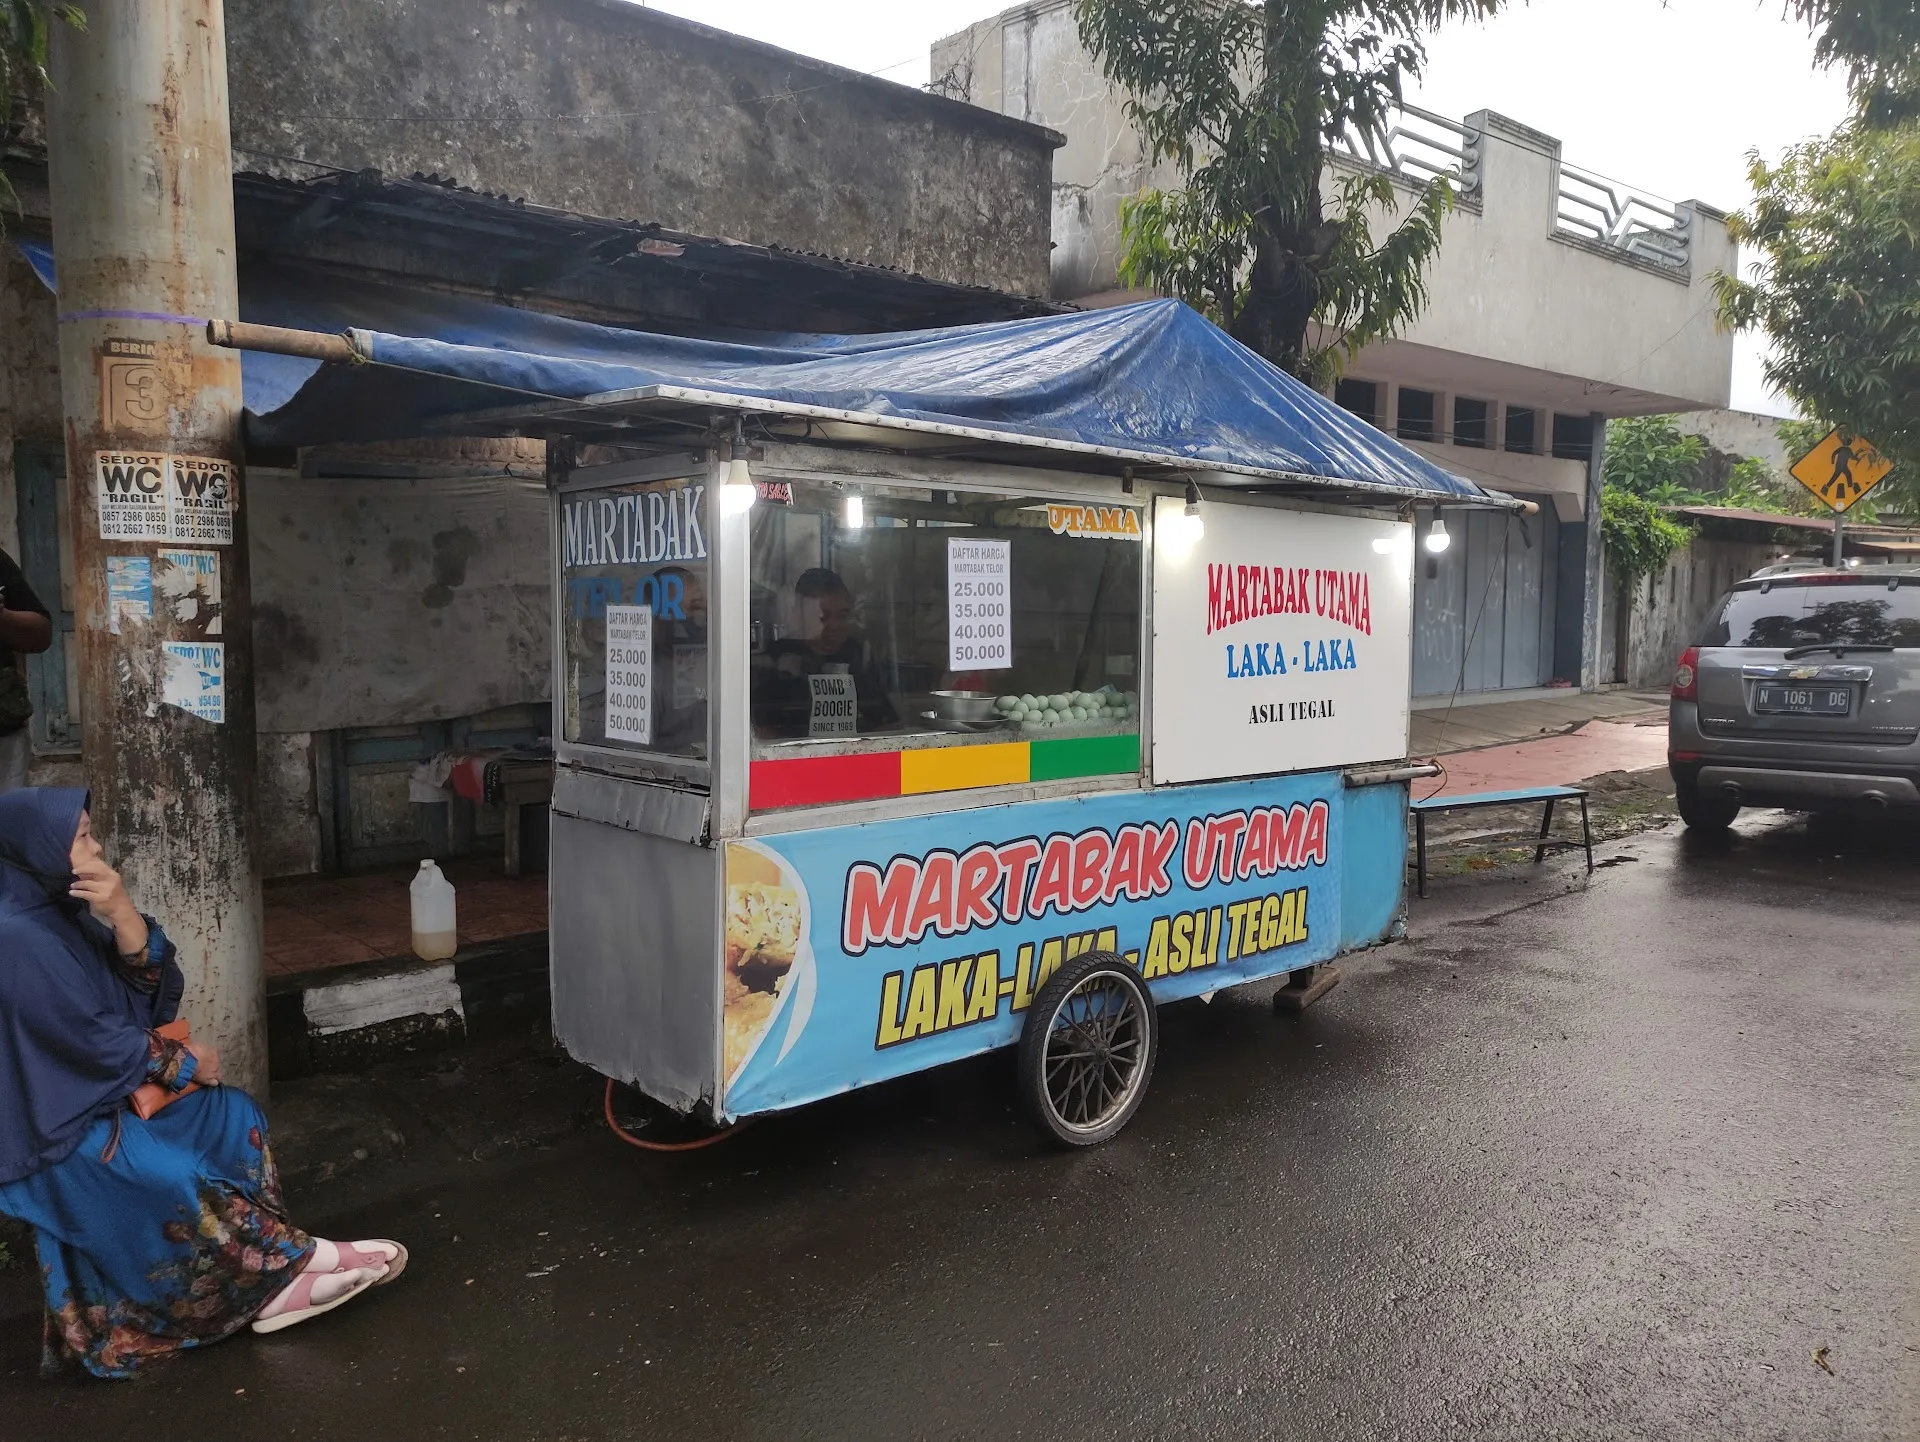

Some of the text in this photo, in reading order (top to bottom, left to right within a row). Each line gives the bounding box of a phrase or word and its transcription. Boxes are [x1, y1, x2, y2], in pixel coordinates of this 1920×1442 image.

[100, 455, 163, 466] SEDOT
[173, 460, 228, 472] SEDOT
[102, 465, 162, 494] WC
[175, 469, 228, 499] WC
[102, 512, 166, 522] 0857 2986 0850
[174, 514, 194, 525] 0857
[197, 515, 214, 526] 2986
[564, 485, 707, 567] MARTABAK
[1048, 504, 1140, 538] UTAMA
[102, 524, 167, 535] 0812 2662 7159
[175, 526, 195, 537] 0812
[198, 528, 215, 538] 2662
[952, 547, 1005, 560] DAFTAR HARGA
[196, 555, 215, 574] WC
[954, 563, 1004, 573] MARTABAK TELOR
[954, 582, 1004, 597] 25.000
[1207, 563, 1310, 635] MARTABAK
[1315, 569, 1371, 636] UTAMA
[609, 612, 647, 626] DAFTAR HARGA
[954, 603, 1004, 618] 35.000
[954, 623, 1005, 639] 40.000
[202, 647, 220, 668] WC
[610, 648, 646, 666] 25.000
[955, 644, 1005, 660] 50.000
[1227, 642, 1287, 678] LAKA
[1304, 638, 1357, 673] LAKA
[610, 670, 646, 688] 35.000
[813, 678, 845, 696] BOMB
[610, 692, 646, 711] 40.000
[1760, 689, 1847, 706] N 1061 DG
[814, 699, 853, 717] BOOGIE
[1248, 699, 1336, 724] ASLI TEGAL
[610, 714, 646, 734] 50.000
[812, 722, 835, 732] SINCE
[842, 799, 1330, 955] MARTABAK UTAMA
[1142, 903, 1225, 981] ASLI
[1226, 886, 1309, 963] TEGAL
